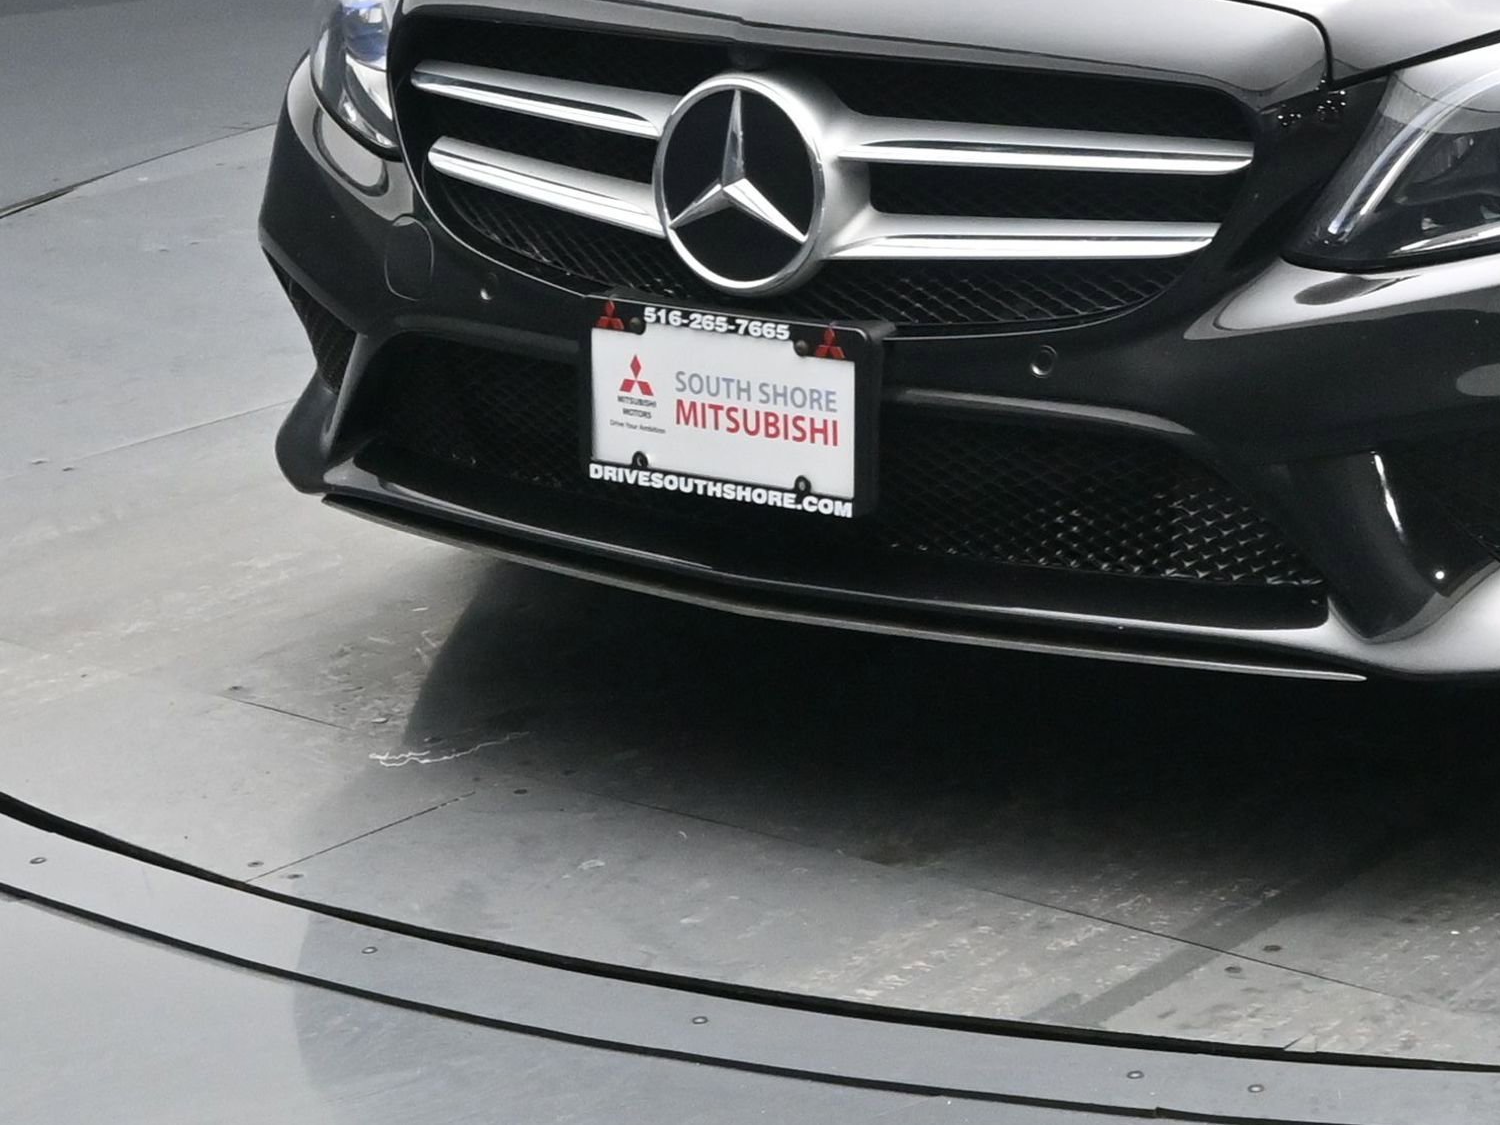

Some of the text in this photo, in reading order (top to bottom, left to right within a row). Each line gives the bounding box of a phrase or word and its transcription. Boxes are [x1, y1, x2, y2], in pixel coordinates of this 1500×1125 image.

[643, 306, 790, 340] 516-265-7665
[675, 371, 837, 413] SOUTH SHORE
[675, 399, 839, 446] MITSUBISHI
[589, 463, 852, 518] DRIVESOUTHSHORE.COM
